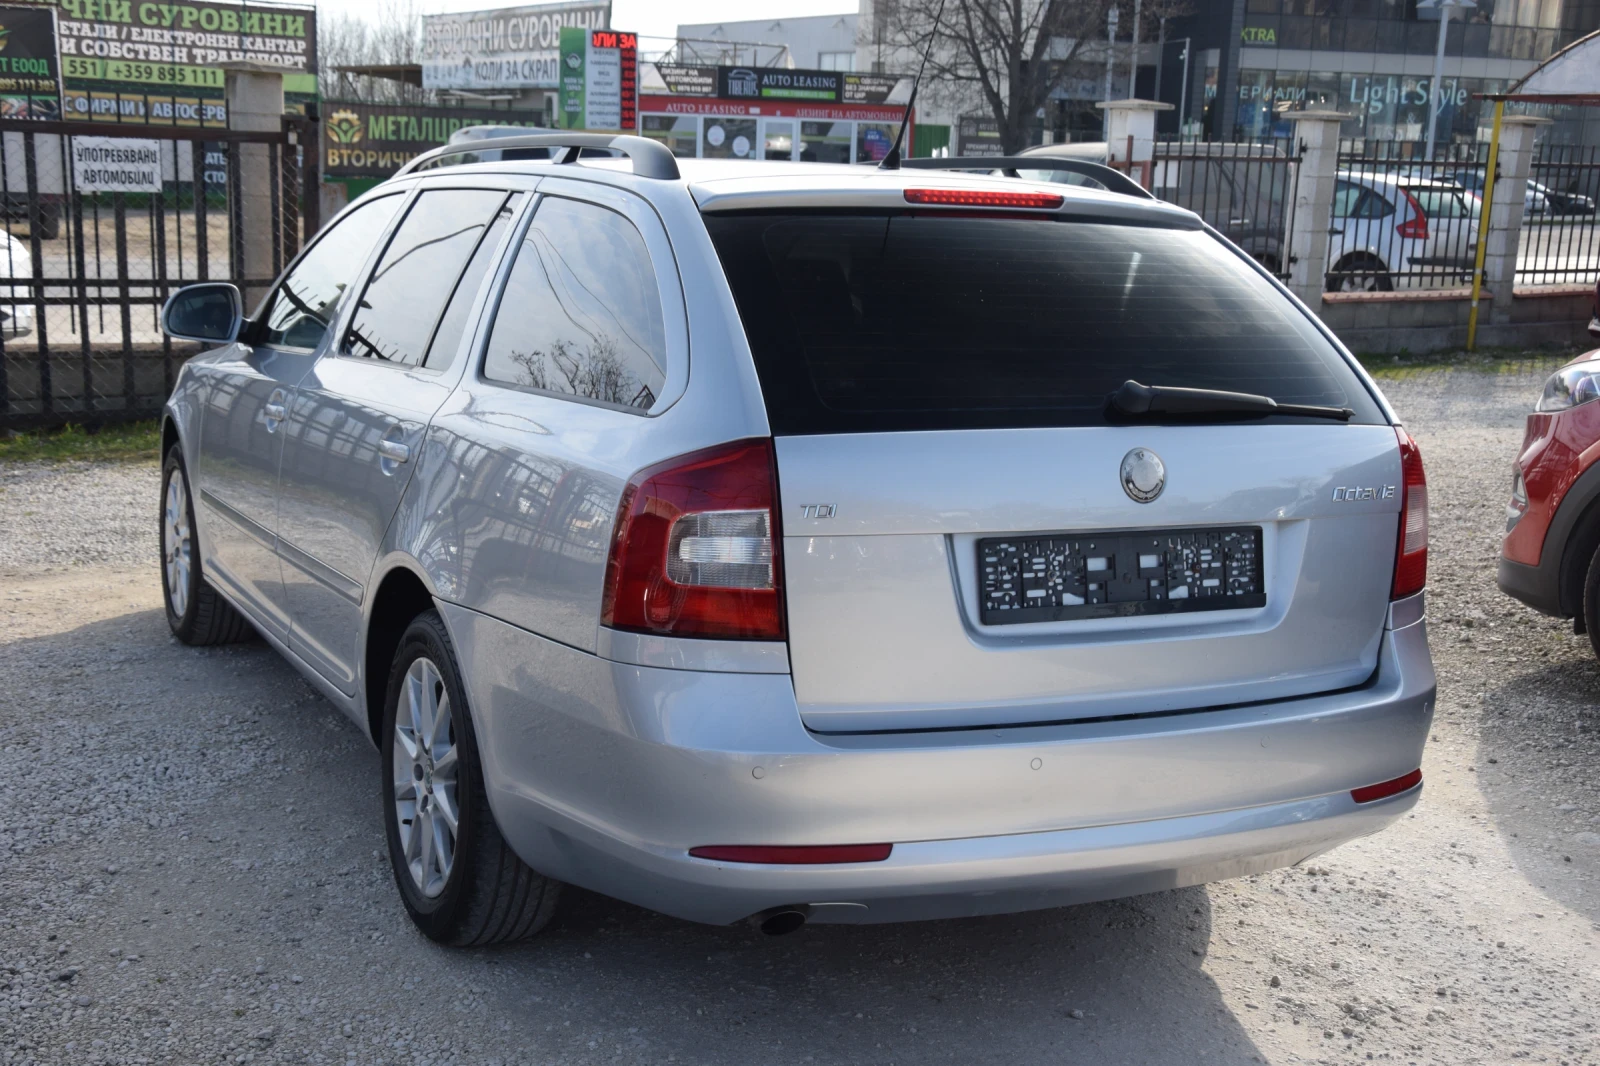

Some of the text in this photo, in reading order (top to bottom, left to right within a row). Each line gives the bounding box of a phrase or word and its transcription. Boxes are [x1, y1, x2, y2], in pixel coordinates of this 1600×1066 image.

[139, 3, 305, 37] СУРОВИНИ
[60, 20, 118, 39] ЕТАЛИ
[130, 27, 239, 49] ЕЛЕКТРОНЕН
[242, 36, 306, 54] КАНТАР
[424, 19, 505, 55] ВТОРИЧНИ
[619, 34, 637, 49] ЗА
[61, 37, 77, 54] И
[81, 39, 189, 63] СОБСТВЕН
[11, 58, 50, 77] ЕООД
[69, 59, 98, 76] 551
[113, 63, 153, 80] +359
[157, 66, 187, 83] 895
[191, 69, 217, 84] 111
[475, 63, 502, 80] КОЛИ
[505, 61, 520, 79] ЗА
[522, 58, 558, 79] СКРАП
[666, 76, 713, 86] АВТОМОБИЛИ
[762, 74, 837, 89] AUTO LEASING
[1348, 77, 1408, 114] Light
[75, 97, 135, 115] ФИРМИ
[665, 103, 745, 115] AUTO LEASING
[795, 108, 903, 121] ЛИЗИНГ НА АВТОМОБИЛИ
[76, 147, 157, 164] УПОТРЕБЯВАНИ
[83, 169, 154, 185] АВТОМОБИЛИ
[1332, 484, 1396, 503] Octavia
[799, 503, 837, 519] TDI
